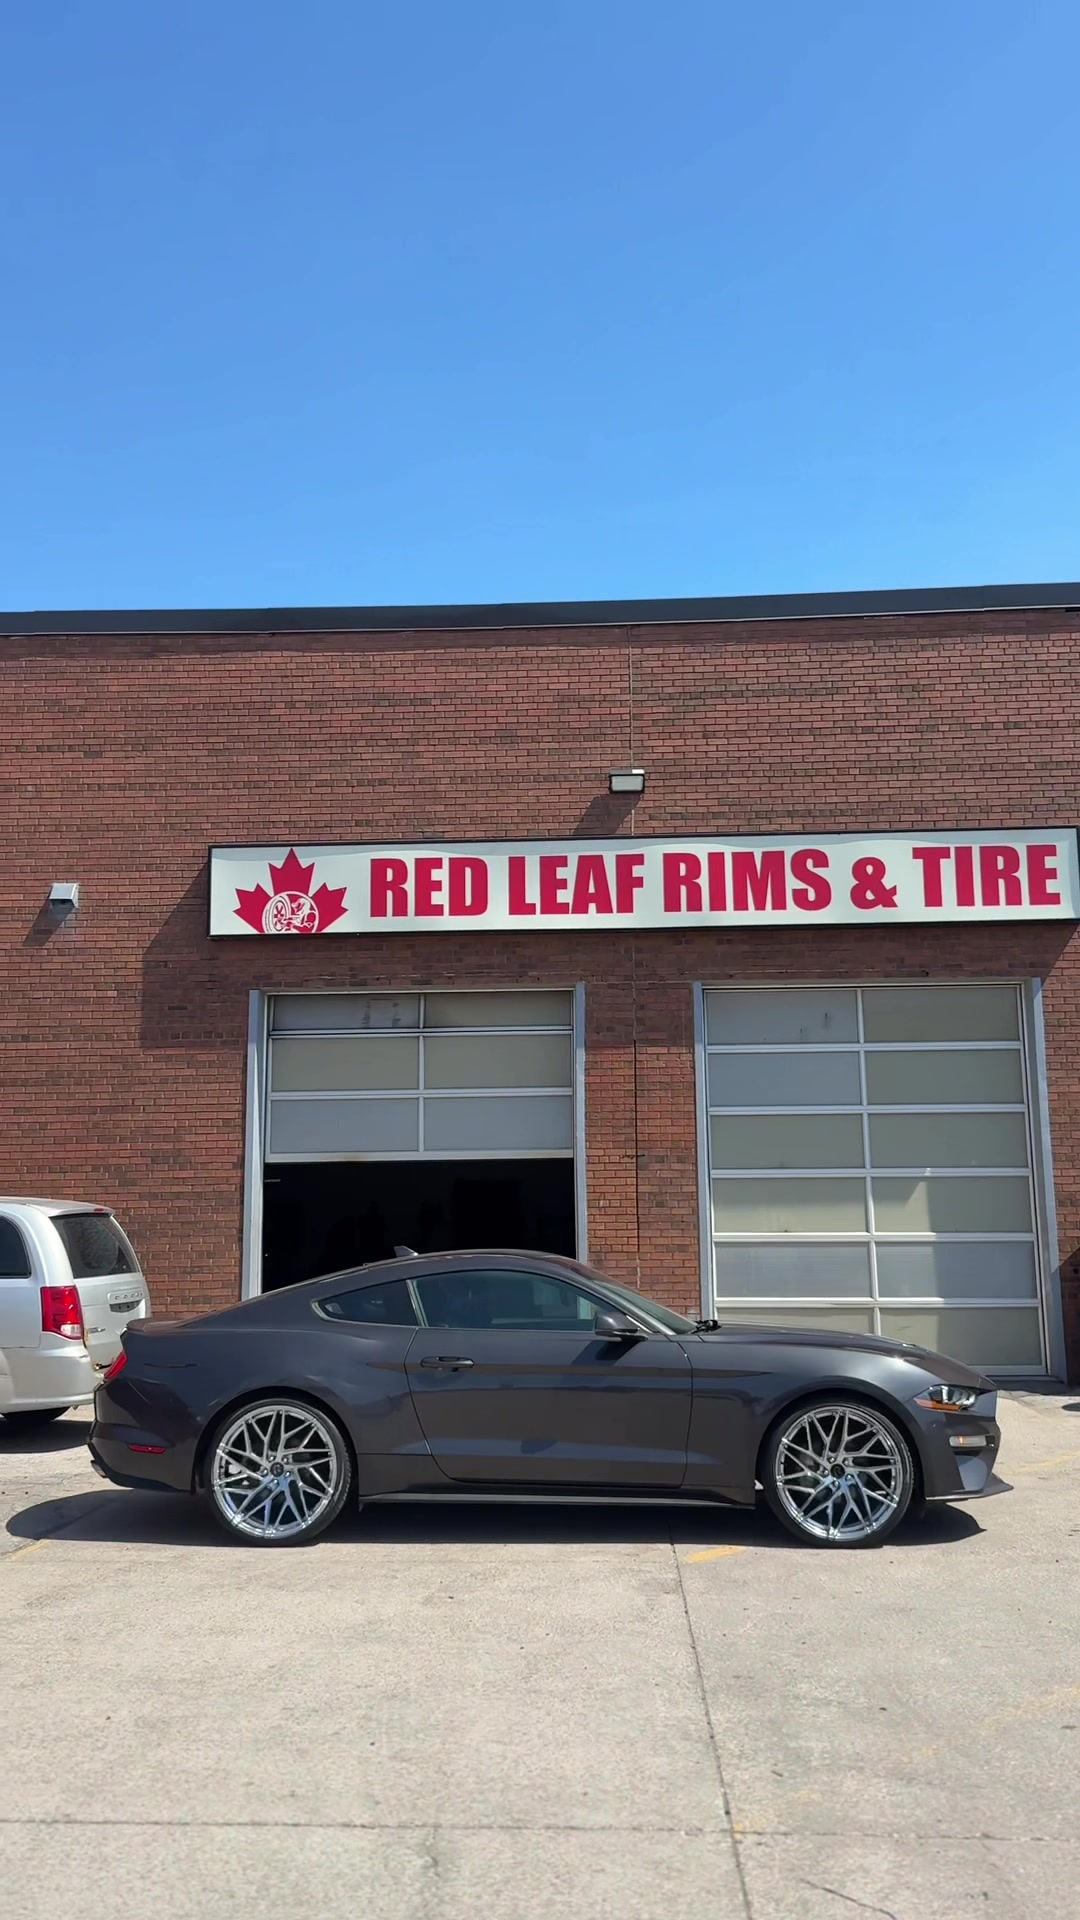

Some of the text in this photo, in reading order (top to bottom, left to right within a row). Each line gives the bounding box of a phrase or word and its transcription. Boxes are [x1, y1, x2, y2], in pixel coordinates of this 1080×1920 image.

[370, 845, 1062, 918] RED LEAF RIMS & TIRE
